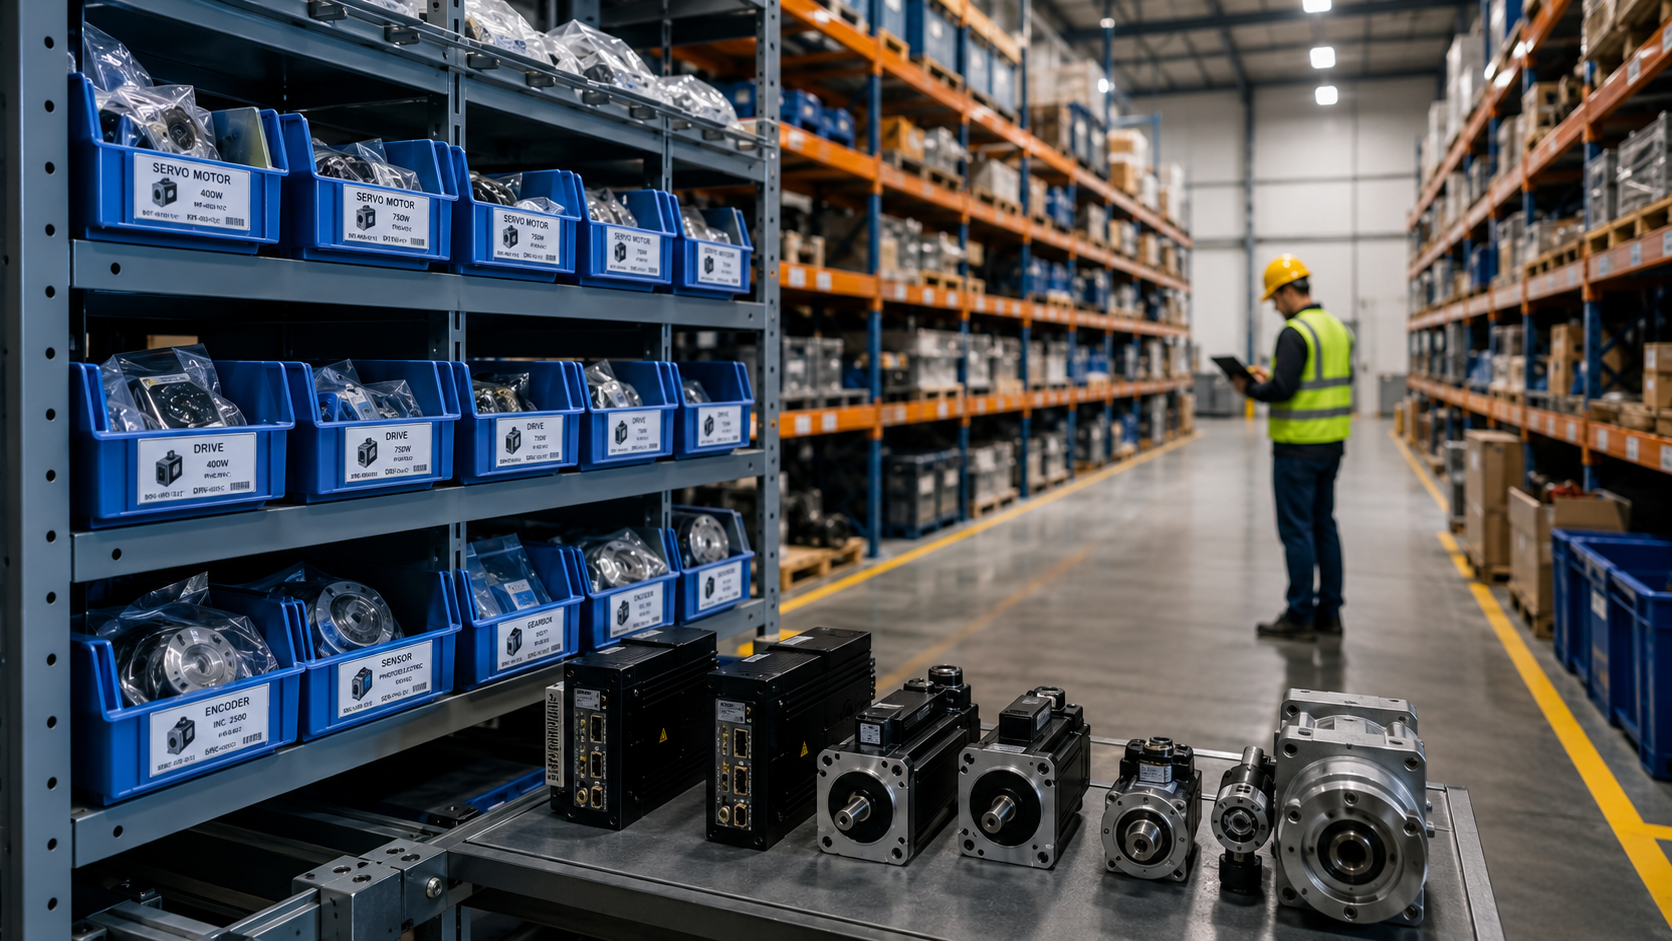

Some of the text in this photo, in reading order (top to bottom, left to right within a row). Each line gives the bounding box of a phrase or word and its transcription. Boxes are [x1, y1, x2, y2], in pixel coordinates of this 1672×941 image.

[152, 162, 231, 185] SERVO MOTOR
[200, 189, 223, 200] 400W
[356, 192, 415, 210] SERVO MOTOR
[504, 214, 549, 230] SERVO MOTOR
[386, 431, 408, 441] DRIVE
[193, 442, 224, 454] DRIVE
[394, 445, 412, 453] 750W
[206, 459, 229, 468] 400W
[381, 652, 412, 668] SENSOR
[205, 696, 250, 717] ENCODER
[213, 718, 226, 729] INC
